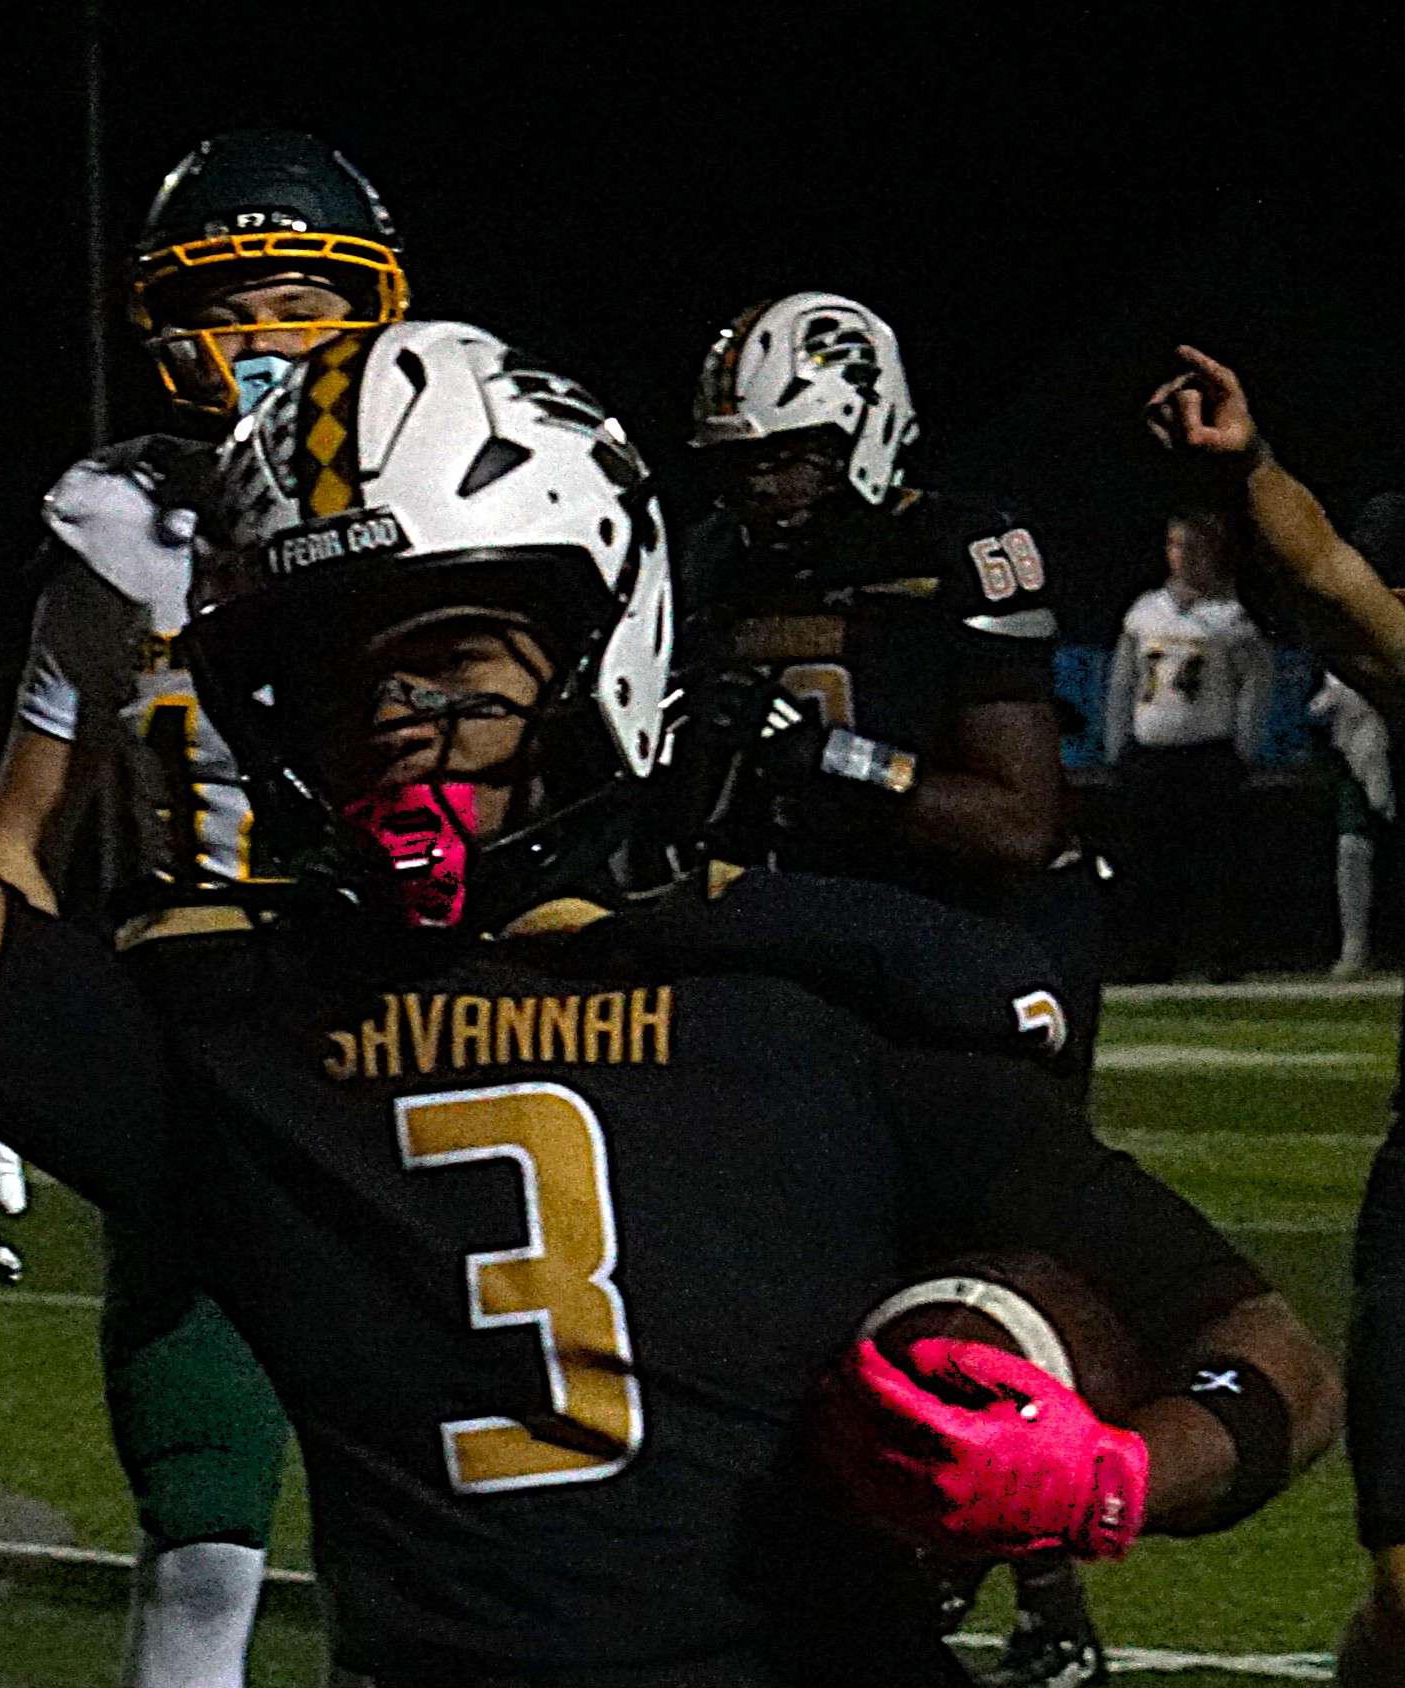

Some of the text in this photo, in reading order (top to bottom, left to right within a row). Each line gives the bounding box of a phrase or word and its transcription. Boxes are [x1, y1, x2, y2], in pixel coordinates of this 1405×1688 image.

[346, 517, 399, 553] GOD
[323, 984, 675, 1080] SAVANNAH
[394, 1080, 645, 1496] 3
